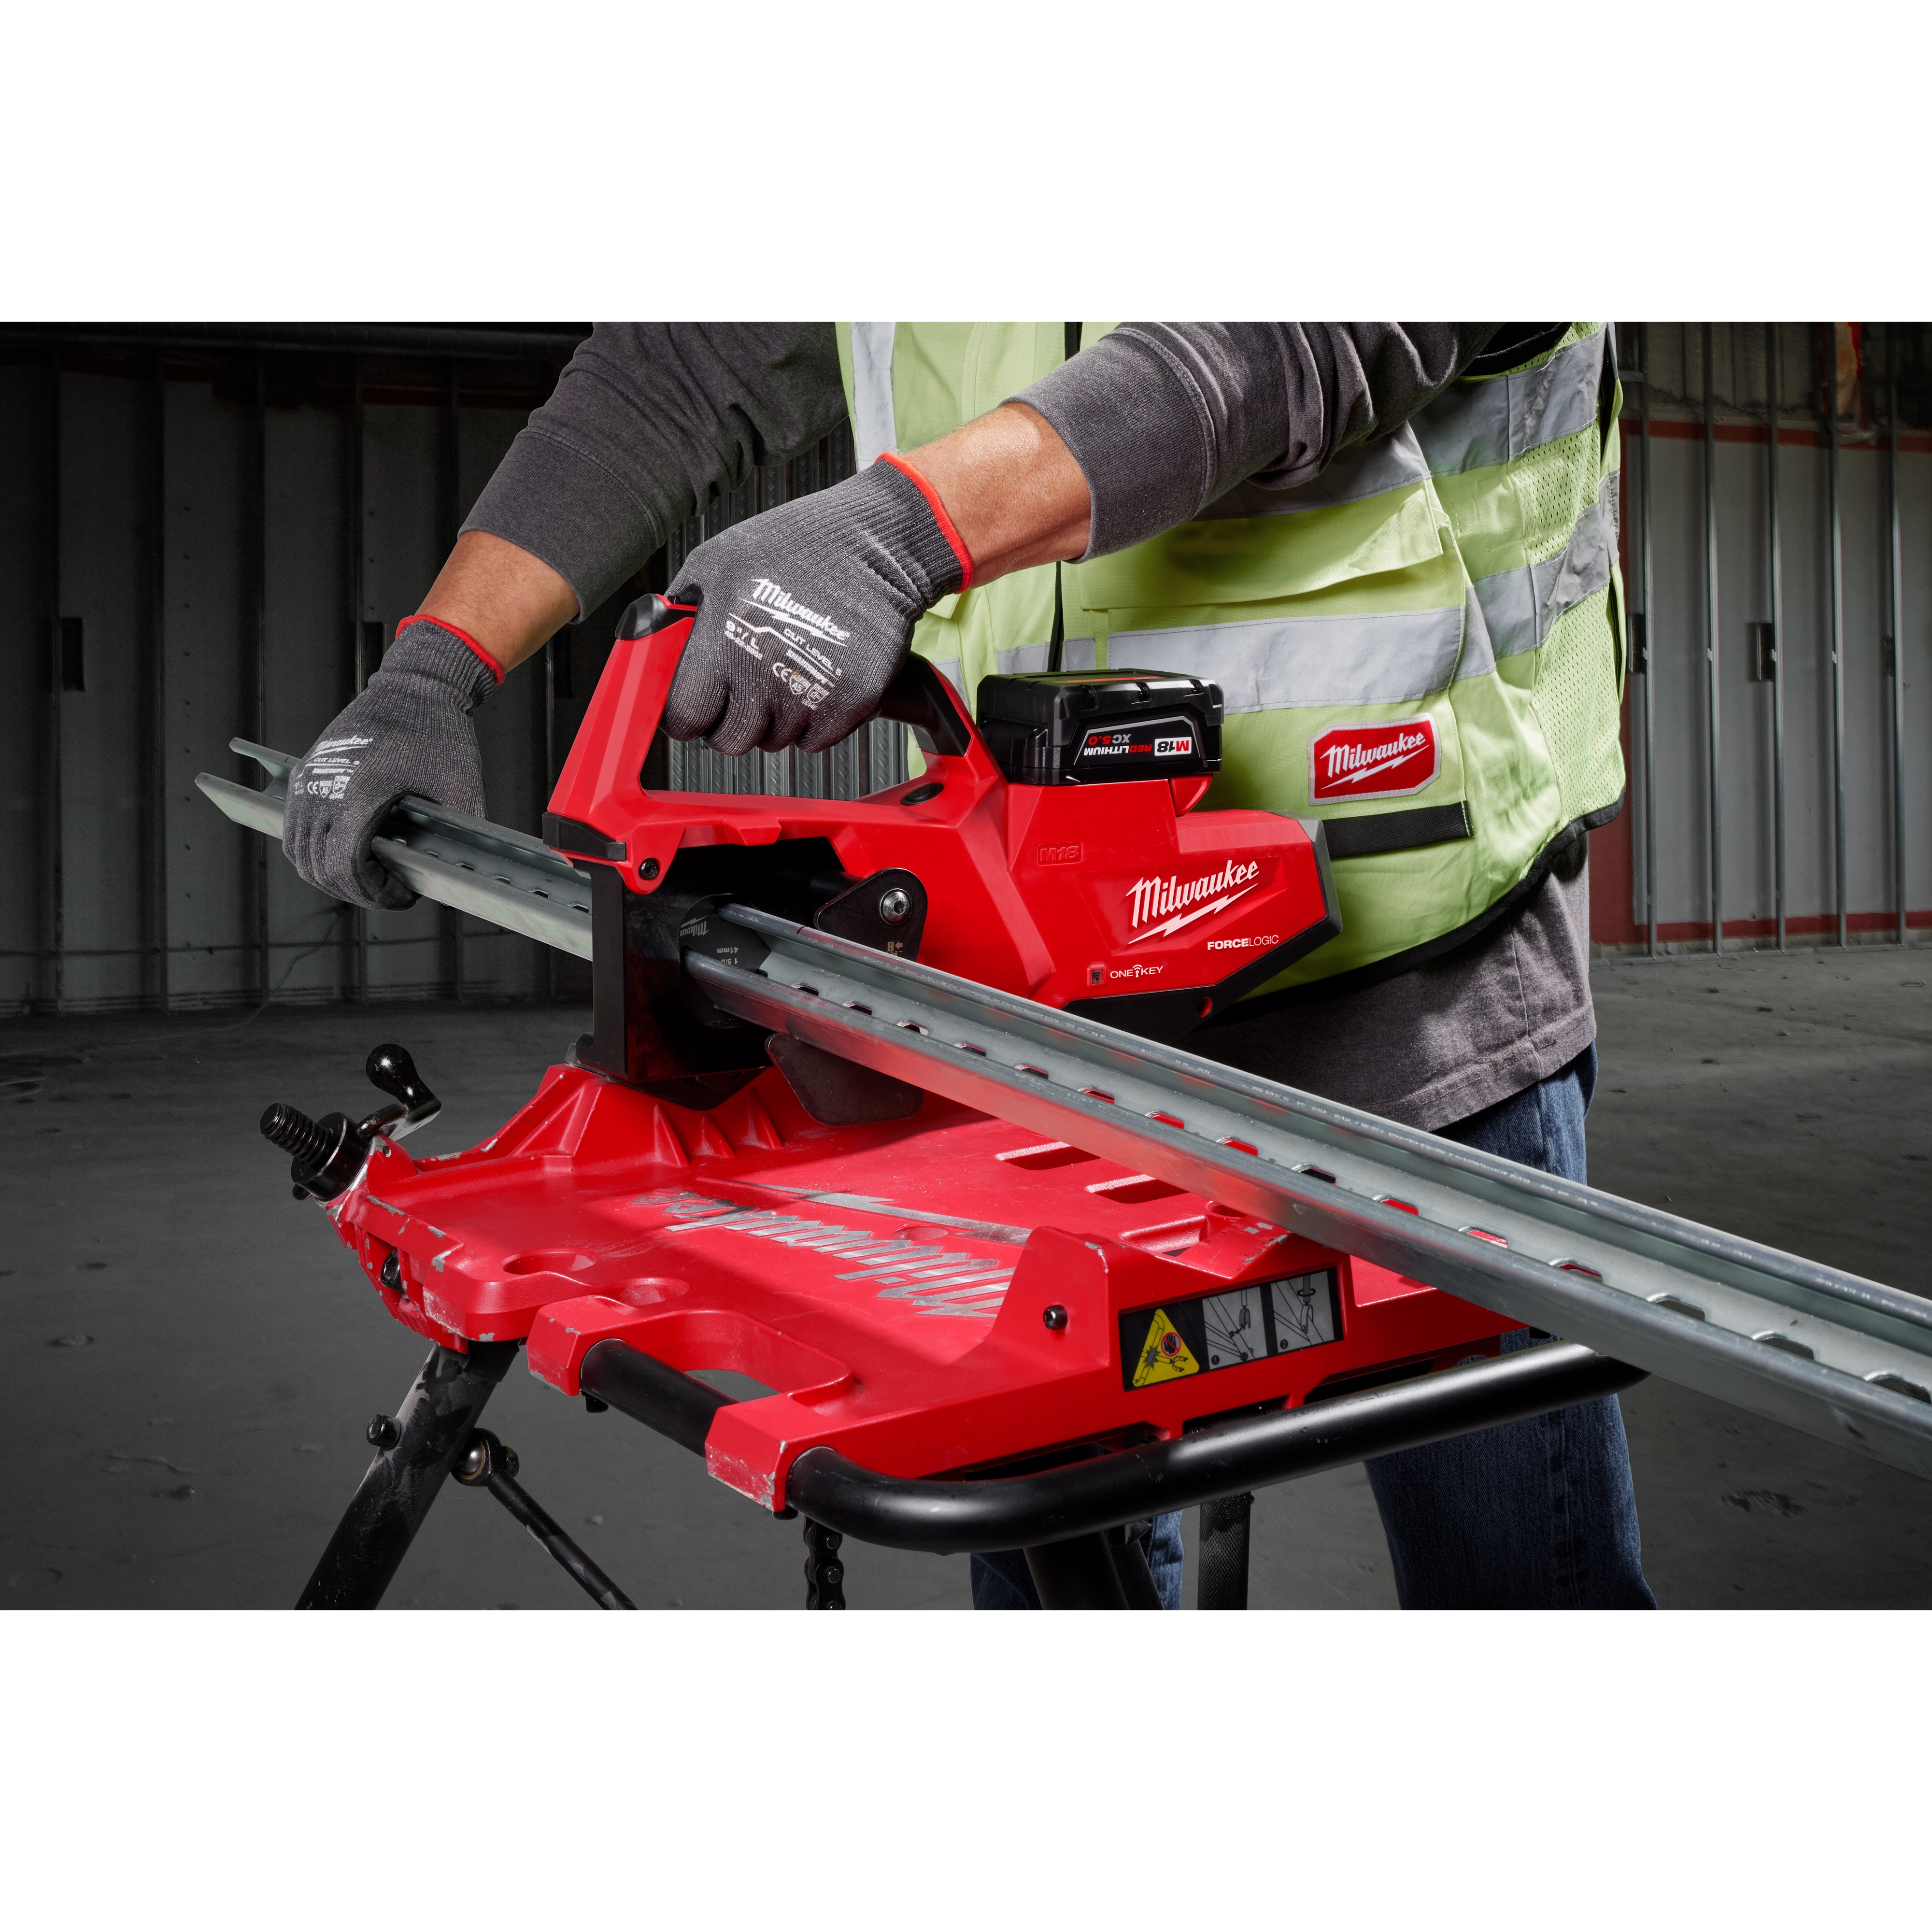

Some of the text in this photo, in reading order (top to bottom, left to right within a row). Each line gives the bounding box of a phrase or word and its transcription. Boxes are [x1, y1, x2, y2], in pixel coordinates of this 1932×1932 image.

[784, 629, 842, 676] CUT LEVEL 5
[1084, 739, 1190, 756] M18 REDLITHIUM
[1088, 734, 1132, 745] XC5.0
[1320, 732, 1425, 778] Milwaukee
[1039, 846, 1080, 862] M18
[1126, 860, 1259, 928] Milwaukee
[1207, 935, 1279, 951] FORCELOGIC
